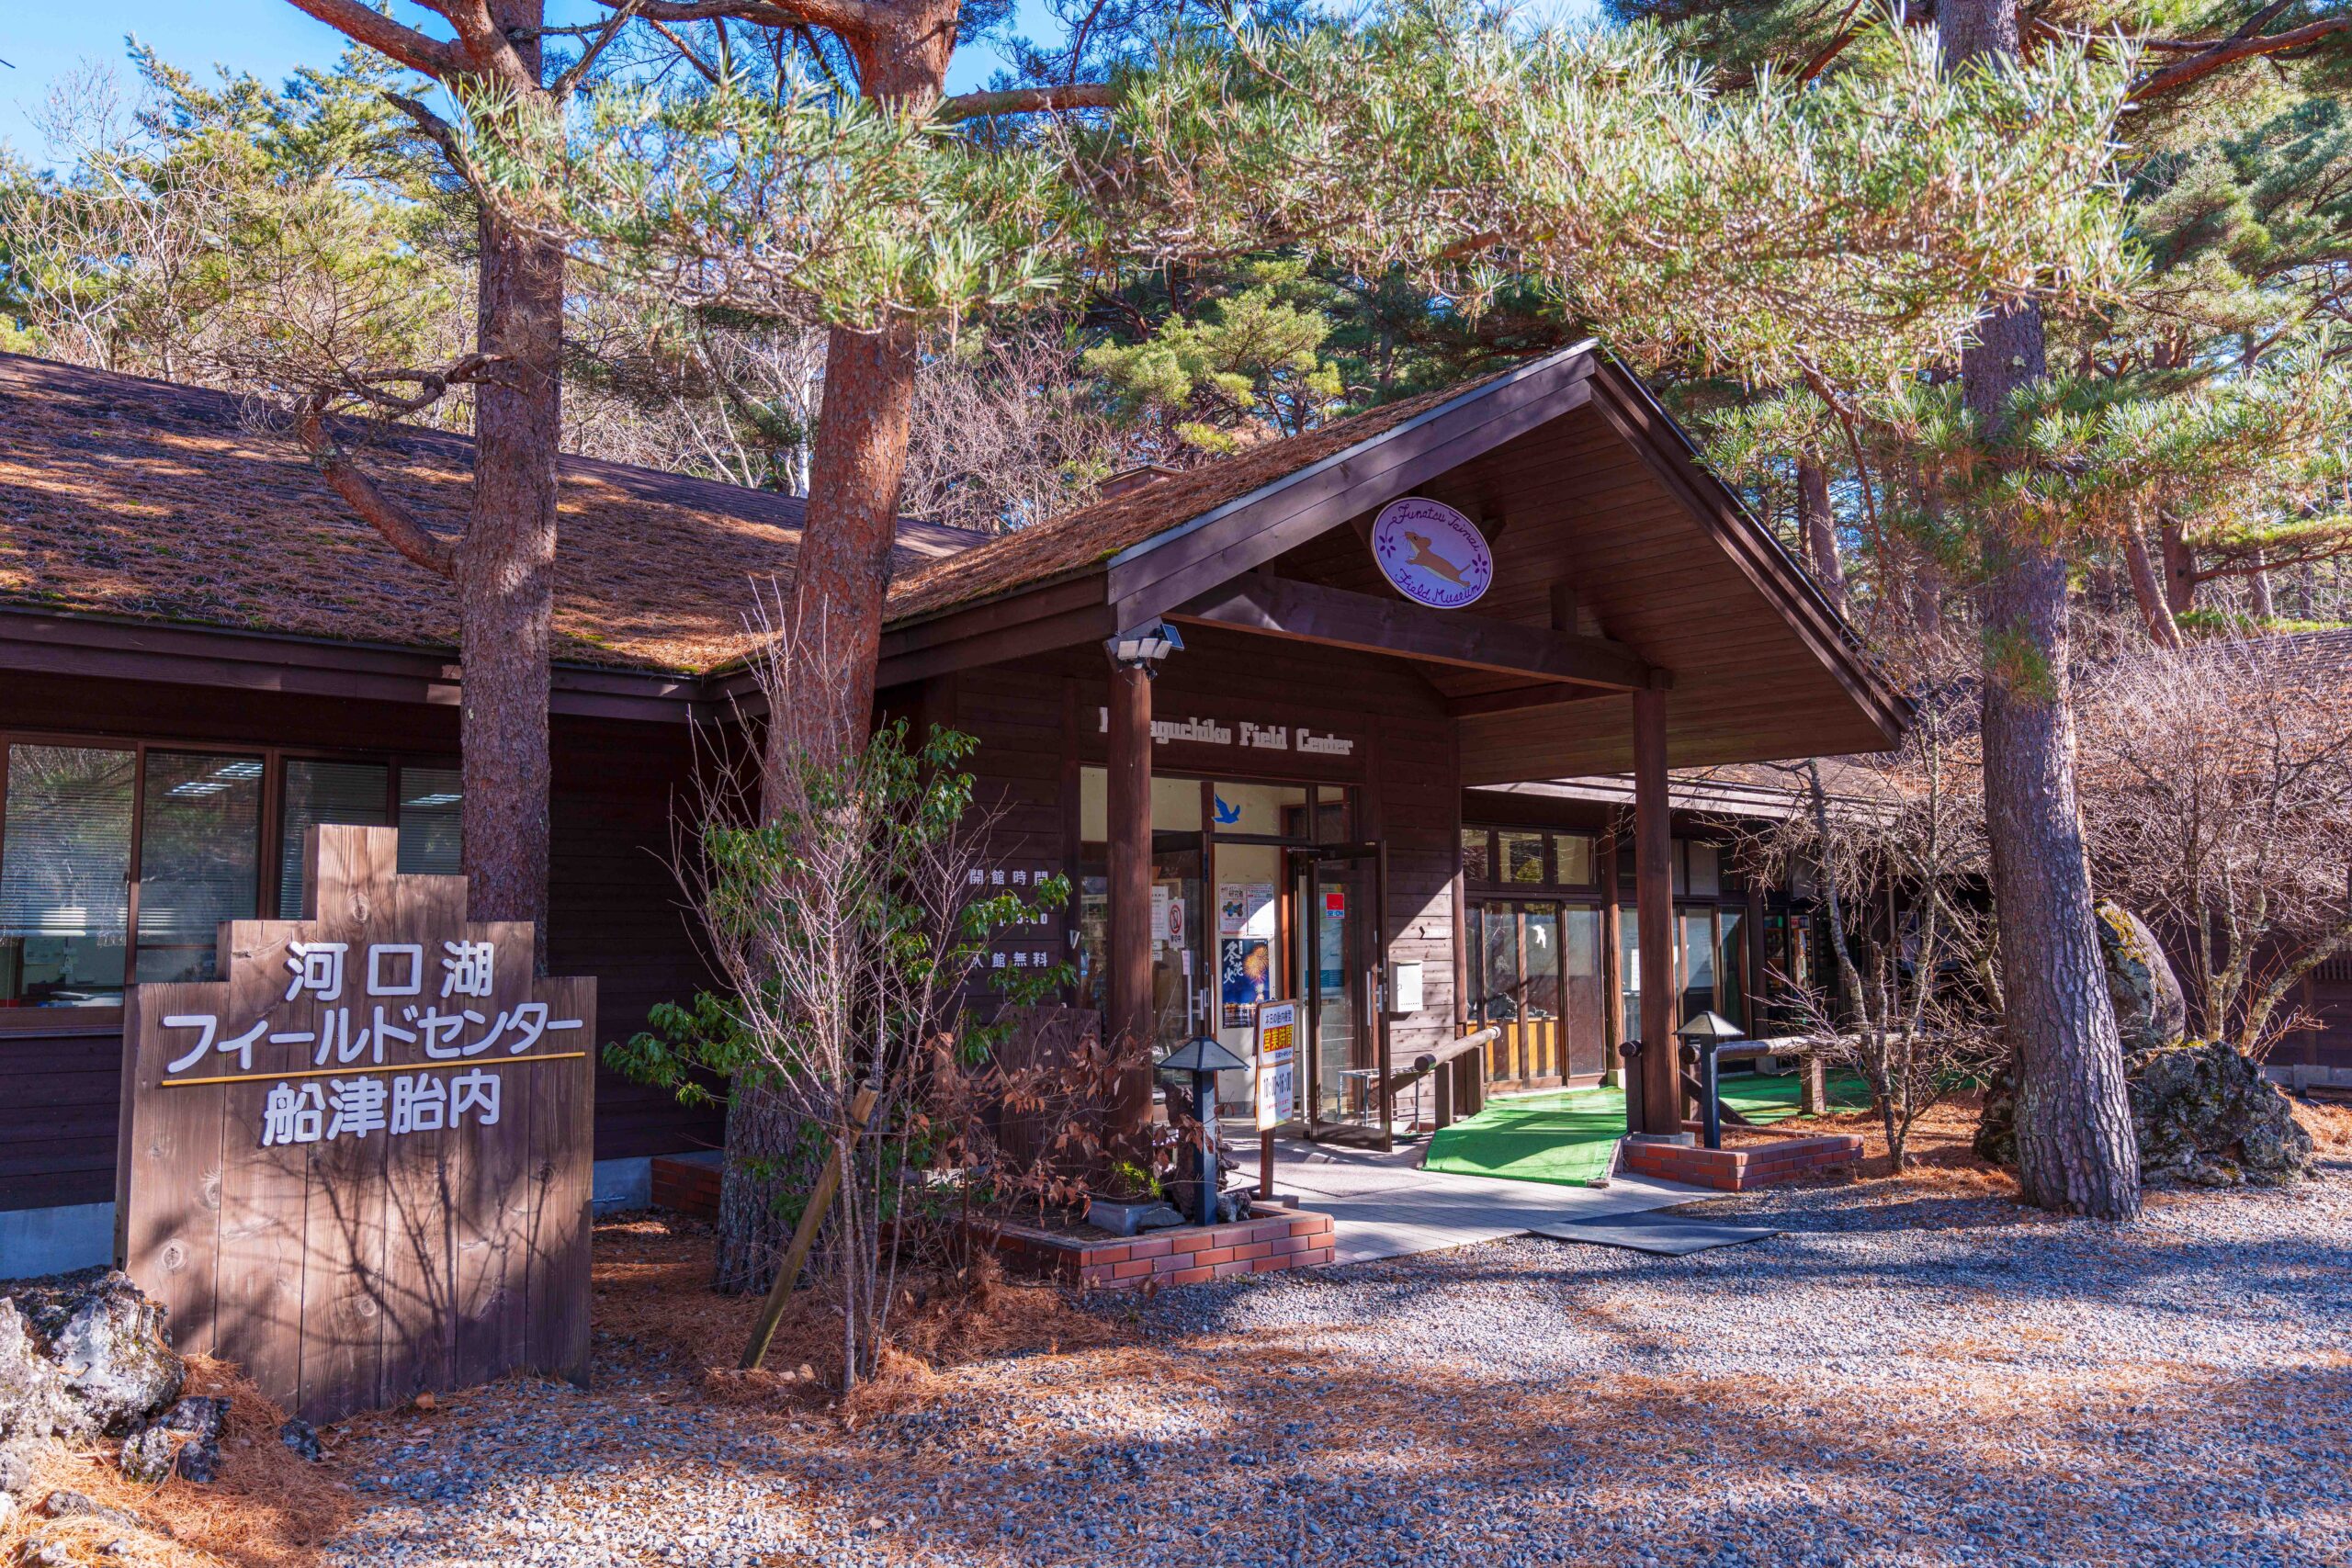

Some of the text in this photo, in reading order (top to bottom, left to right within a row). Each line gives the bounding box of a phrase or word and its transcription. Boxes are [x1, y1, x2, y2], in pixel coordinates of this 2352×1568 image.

[1448, 510, 1483, 551] Tainai
[1395, 568, 1480, 604] Field Museum
[1239, 721, 1288, 750] Field
[1296, 728, 1353, 755] Center
[285, 940, 495, 1002] 河口湖
[163, 1001, 584, 1074] フィールドセンター
[1263, 1025, 1294, 1052] 営業時間
[262, 1068, 501, 1146] 船津胎内
